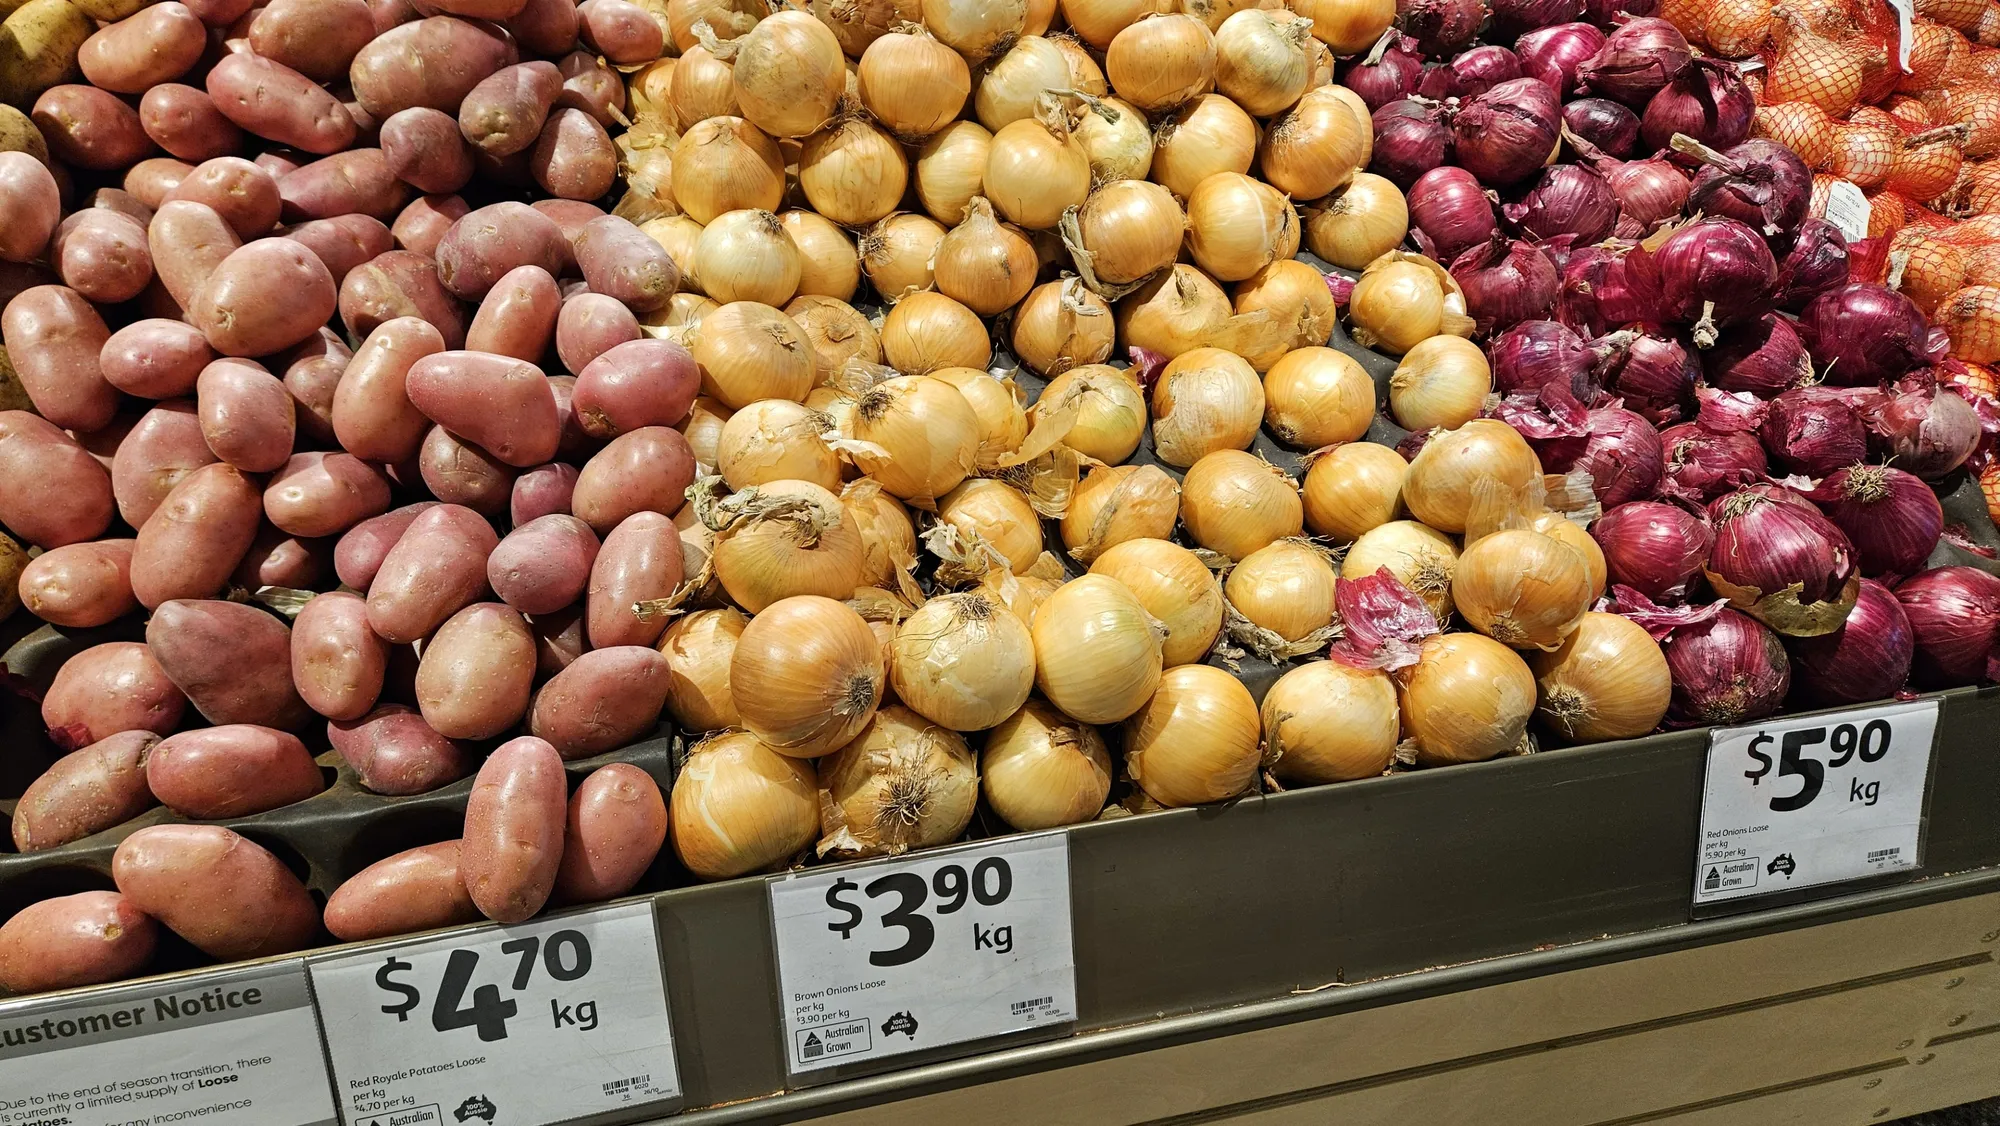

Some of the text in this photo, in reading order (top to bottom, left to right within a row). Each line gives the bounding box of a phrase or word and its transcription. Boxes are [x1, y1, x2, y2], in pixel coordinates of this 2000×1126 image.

[1850, 777, 1880, 806] kg
[1707, 824, 1769, 839] Red Onions Loose
[1706, 840, 1728, 851] per kg
[1724, 849, 1736, 858] per
[1738, 848, 1746, 856] kg
[1723, 862, 1754, 874] Australian
[1722, 877, 1742, 886] Grown
[973, 923, 1013, 954] kg
[794, 979, 886, 1002] Brown Onions Loose
[551, 999, 599, 1031] kg
[796, 1002, 824, 1015] per kg
[822, 1012, 837, 1022] per
[838, 1009, 850, 1018] kg
[0, 987, 262, 1048] ustomer Notice
[892, 1017, 908, 1025] 100%
[825, 1024, 864, 1039] Australian
[890, 1022, 911, 1031] Aussie
[826, 1041, 851, 1053] Grown
[350, 1056, 486, 1089] Red Royale Potatoes Loose
[0, 1056, 271, 1110] Due to the end of season transition, there
[1, 1074, 238, 1123] is currently a limited supply of Loose
[353, 1089, 385, 1103] per kg
[355, 1095, 415, 1112] $4.70 per kg
[153, 1099, 252, 1125] inconvenience
[464, 1107, 488, 1116] Aussie
[466, 1102, 484, 1110] 100%
[390, 1111, 434, 1126] Australian
